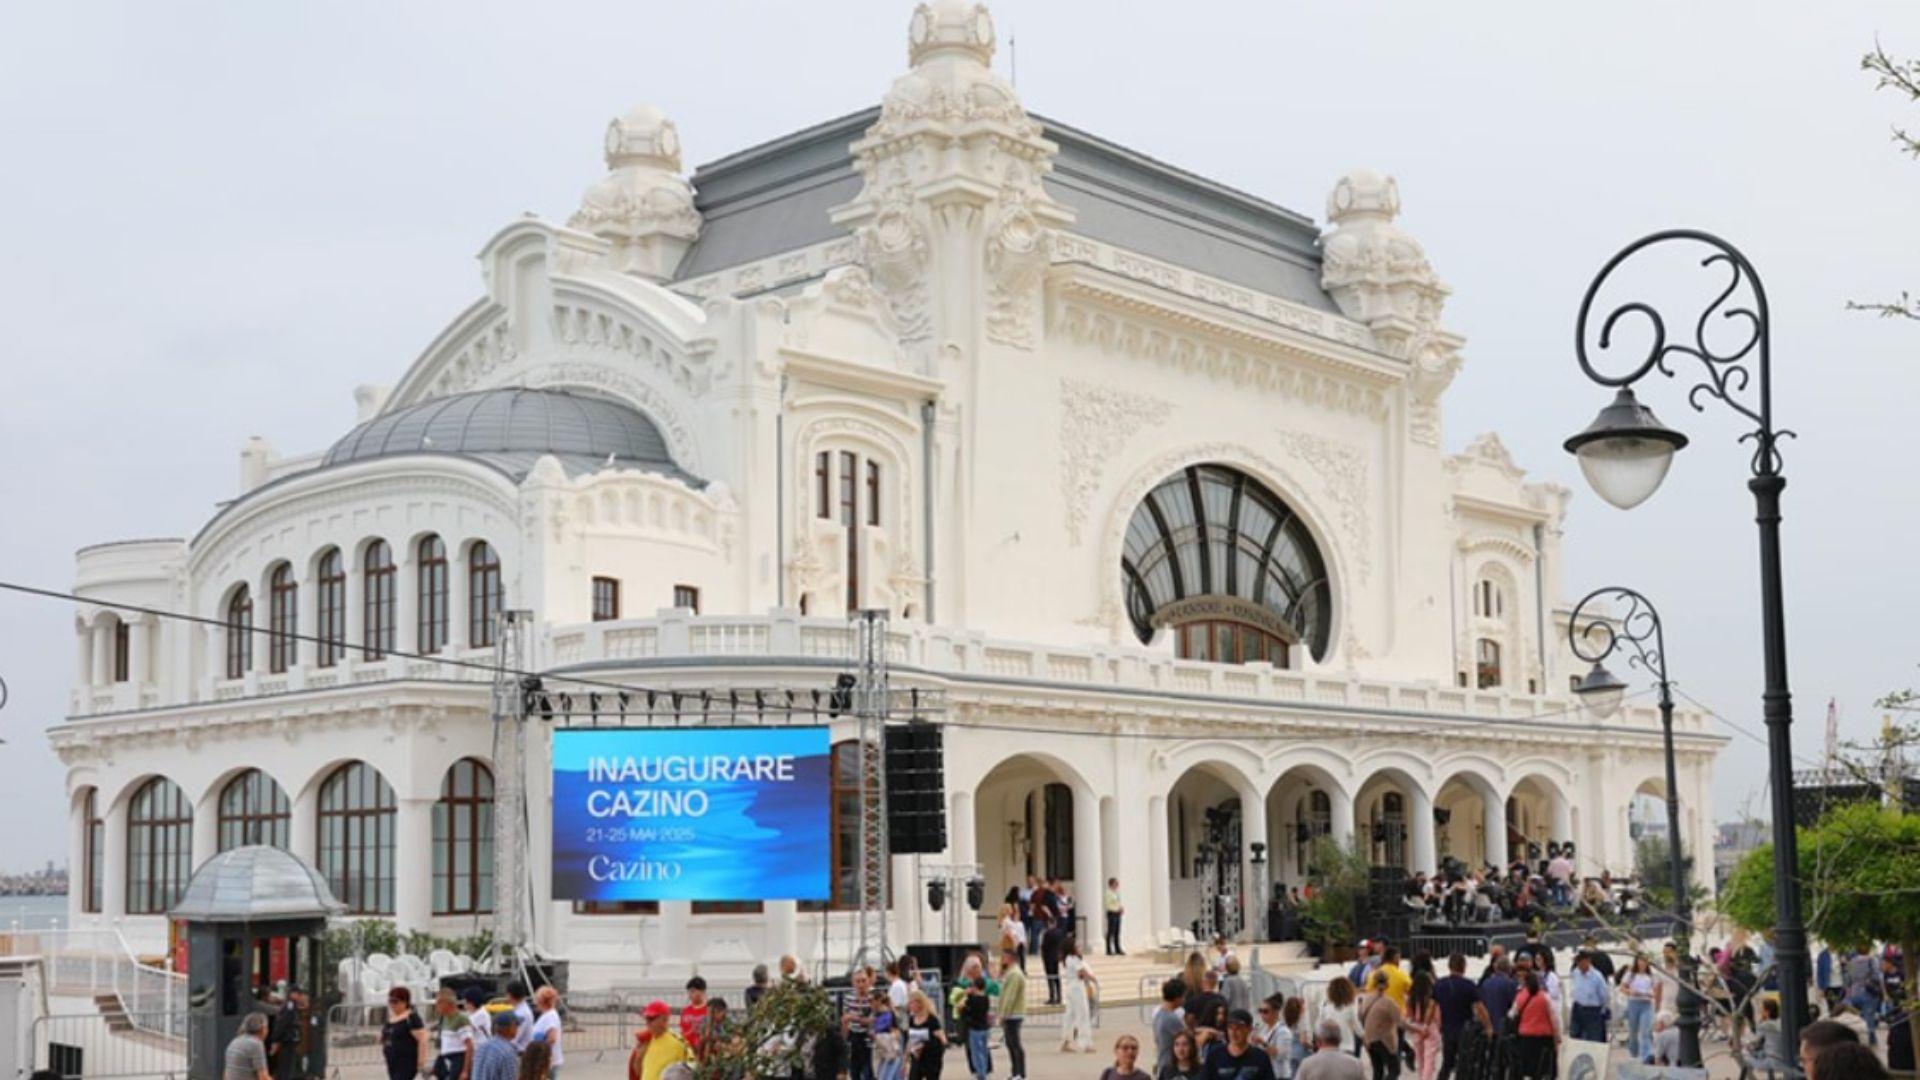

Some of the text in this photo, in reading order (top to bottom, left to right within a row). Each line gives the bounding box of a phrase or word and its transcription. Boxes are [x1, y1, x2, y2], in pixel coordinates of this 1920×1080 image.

[588, 754, 795, 782] INAUGURARE
[587, 790, 709, 817] CAZINO
[586, 828, 627, 842] 21-25
[588, 854, 681, 881] Cazino
